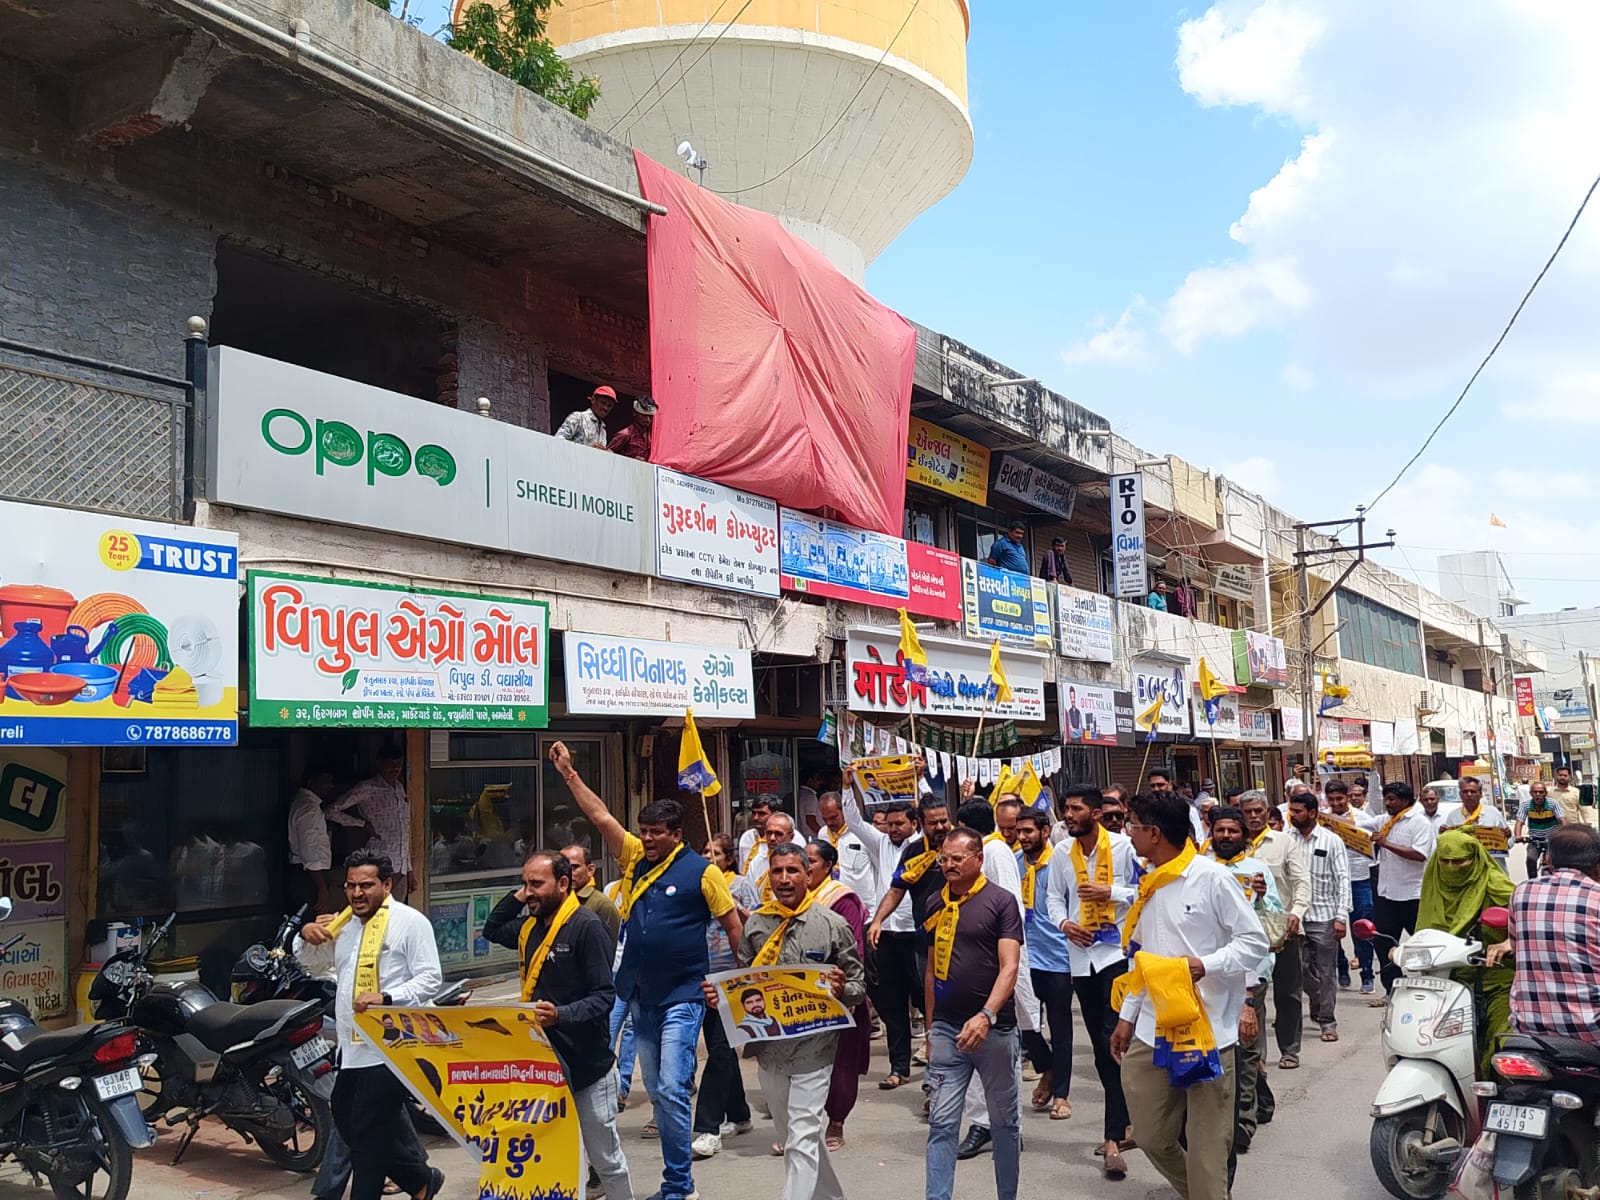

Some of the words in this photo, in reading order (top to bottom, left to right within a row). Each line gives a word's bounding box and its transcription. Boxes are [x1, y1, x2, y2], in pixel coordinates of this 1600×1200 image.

[516, 479, 578, 510] SHREEJI
[582, 494, 634, 523] MOBILE
[1119, 478, 1136, 525] RTO
[727, 510, 776, 553] કોમ્પ્યુટર
[109, 536, 128, 552] 25
[108, 551, 129, 561] Years
[149, 543, 232, 574] TRUST
[699, 552, 714, 563] CCTV
[979, 576, 1010, 597] સરસ્વતી
[263, 585, 378, 673] વિપુલ
[385, 601, 464, 665] એગ્રો
[473, 607, 538, 666] મોલ
[630, 648, 687, 685] વિનાયક
[702, 654, 734, 677] એગ્રો
[450, 668, 474, 690] વિપુલ
[481, 668, 492, 686] ડી.
[693, 678, 747, 710] કેમીકલ્સ
[145, 726, 232, 740] 7878686778
[535, 1070, 546, 1080] આ
[1499, 1106, 1535, 1120] GJ14S
[1497, 1118, 1525, 1131] 4519
